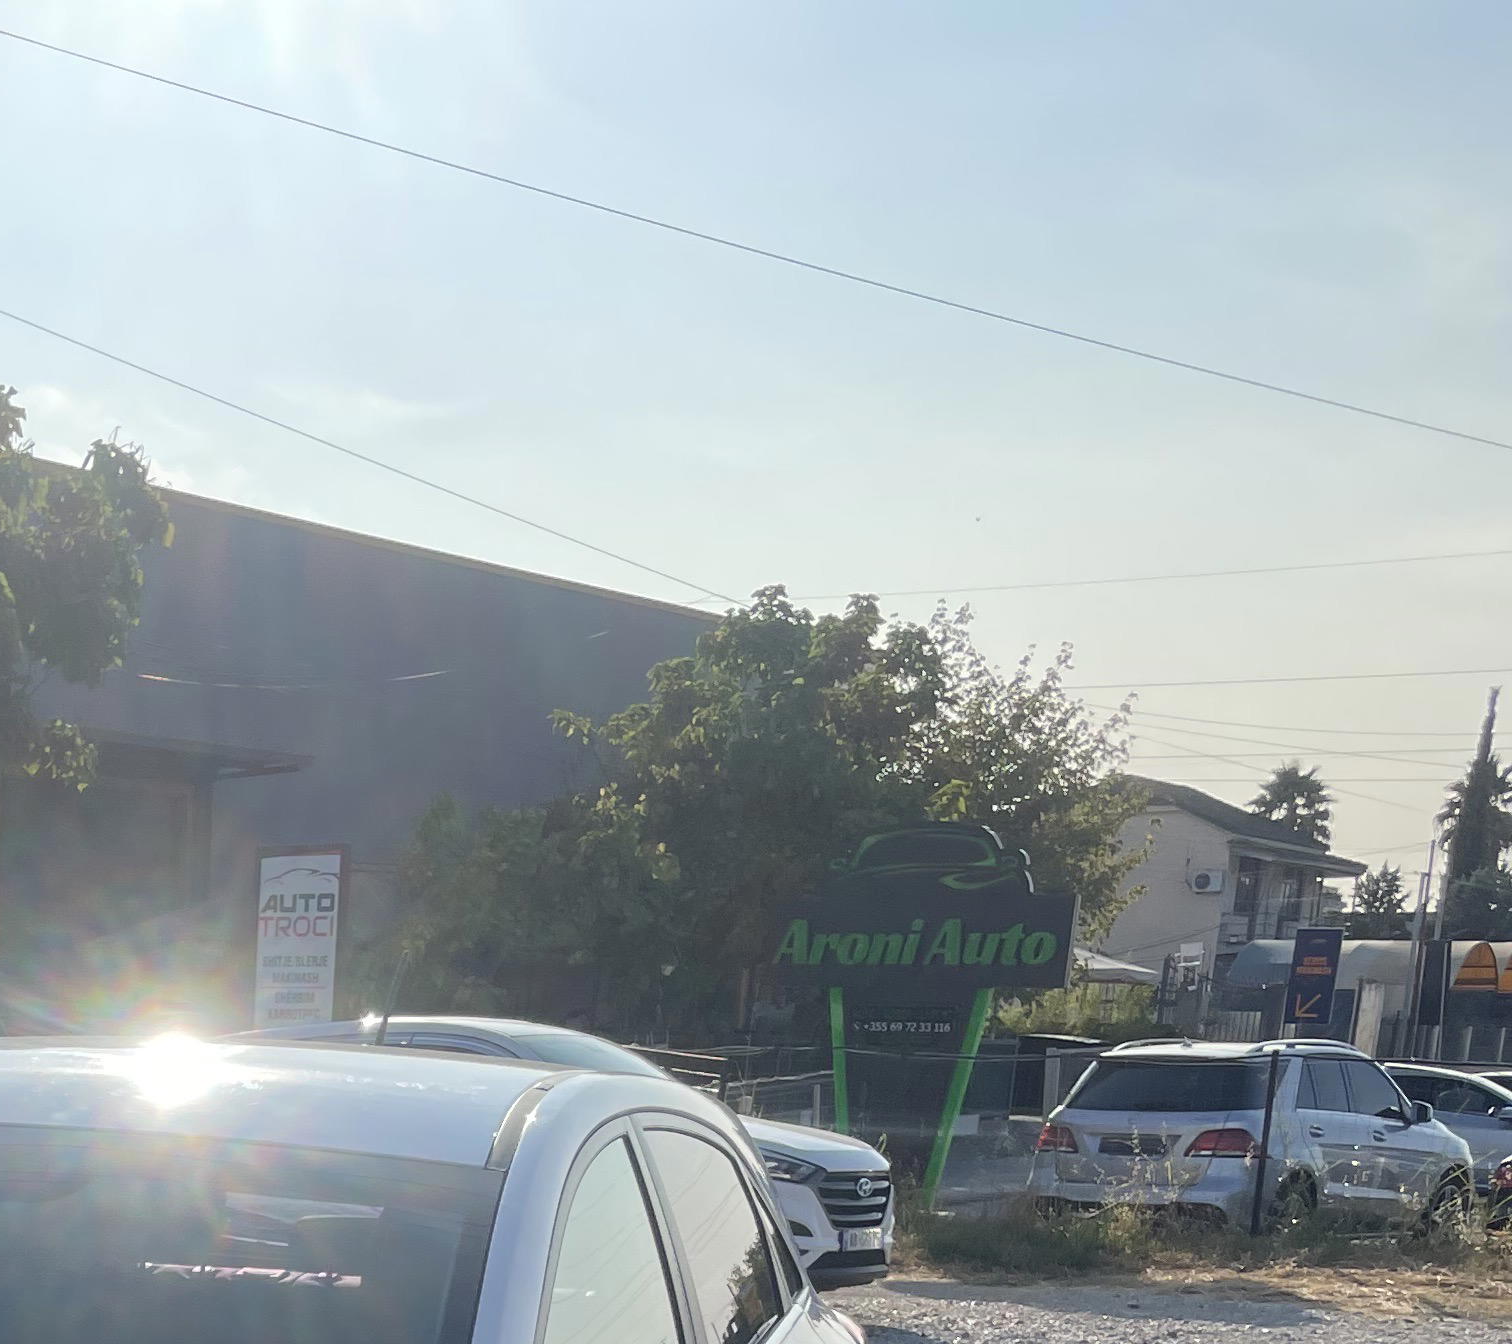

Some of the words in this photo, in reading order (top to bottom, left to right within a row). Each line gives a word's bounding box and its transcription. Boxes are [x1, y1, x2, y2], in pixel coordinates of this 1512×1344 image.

[261, 893, 335, 912] AUTO
[259, 915, 334, 937] TROCI
[772, 917, 926, 966] Aroni
[923, 917, 1058, 966] Auto
